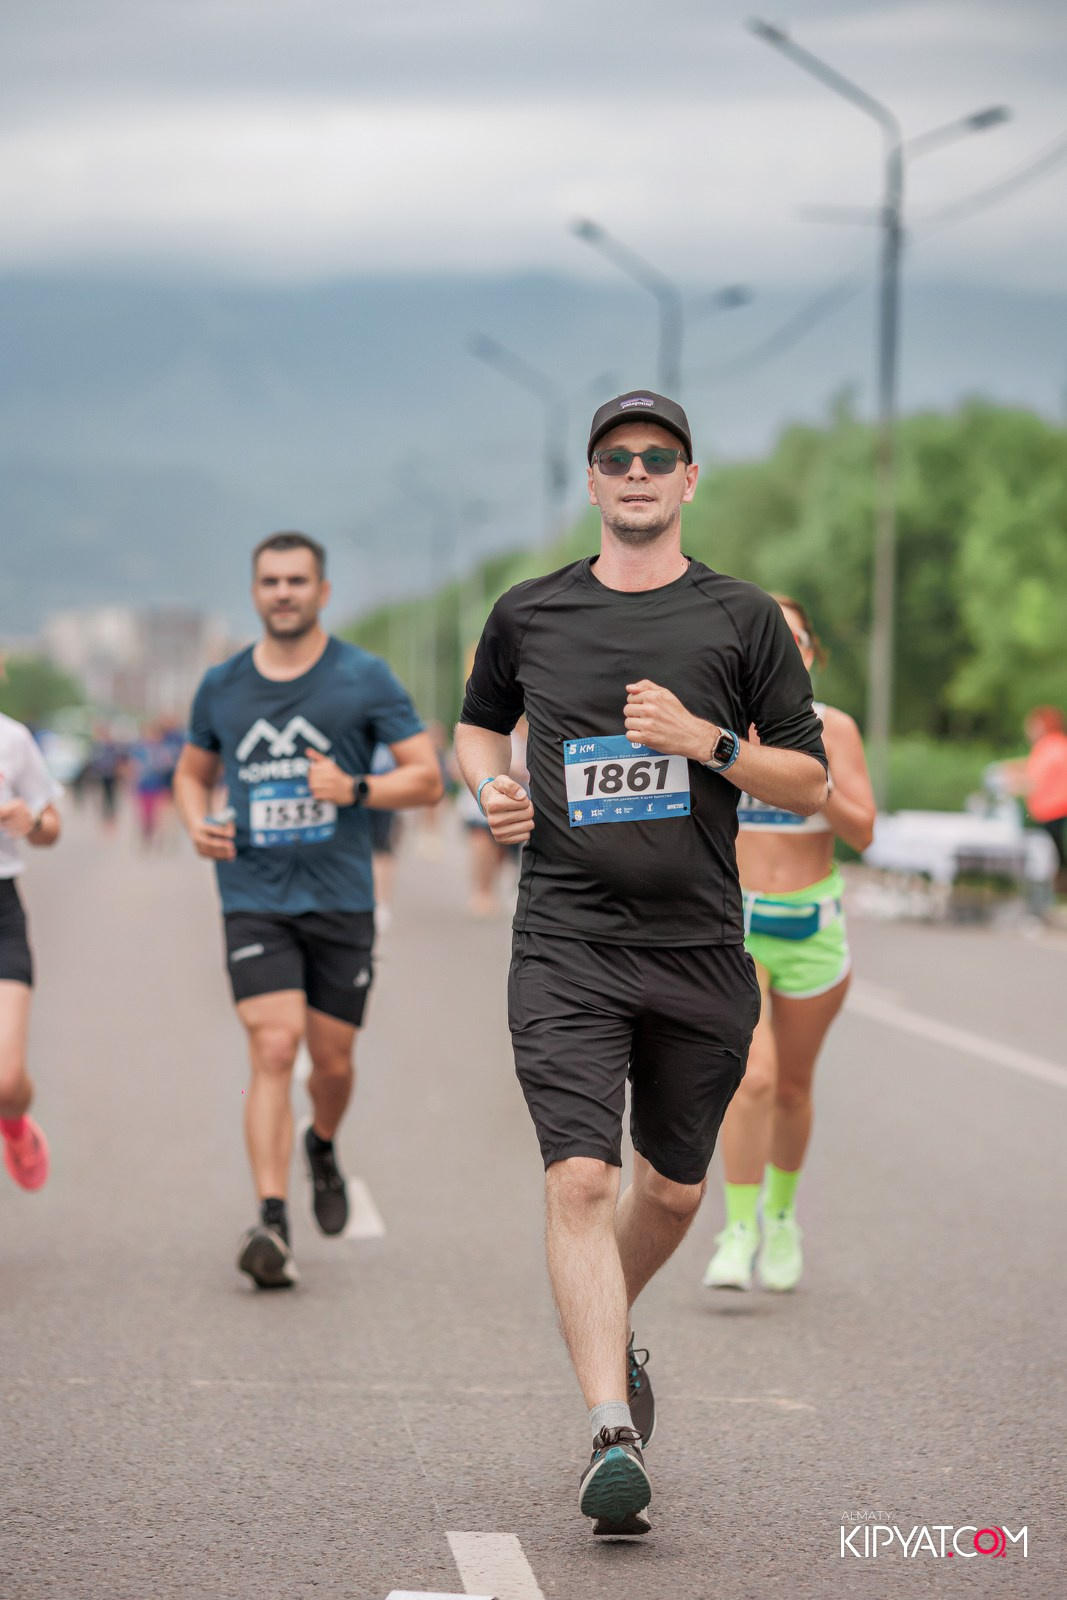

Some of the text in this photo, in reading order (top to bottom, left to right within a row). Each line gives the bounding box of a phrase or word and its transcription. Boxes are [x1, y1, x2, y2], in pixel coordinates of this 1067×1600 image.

[568, 743, 595, 755] 5 KM
[583, 760, 670, 796] 1861
